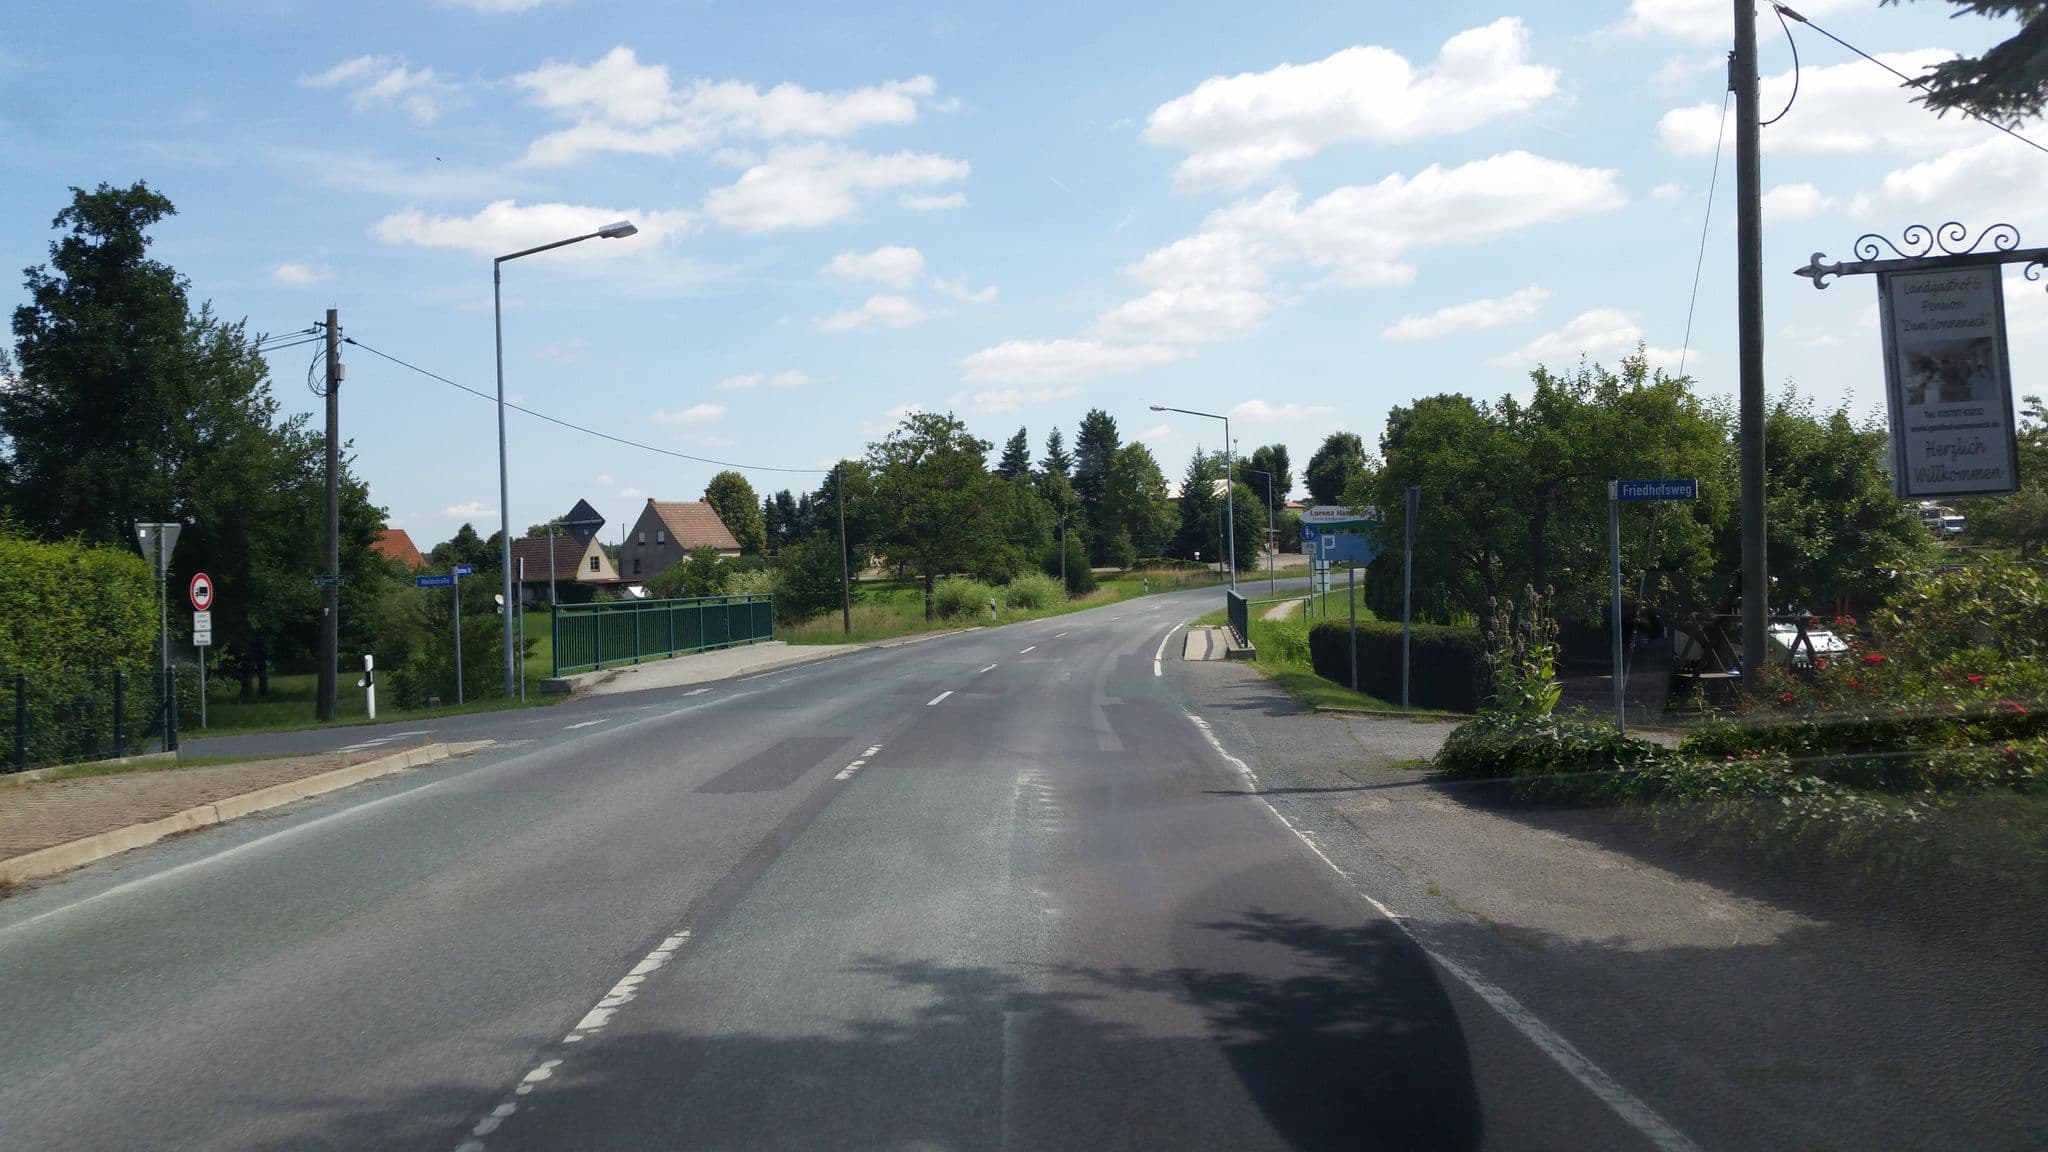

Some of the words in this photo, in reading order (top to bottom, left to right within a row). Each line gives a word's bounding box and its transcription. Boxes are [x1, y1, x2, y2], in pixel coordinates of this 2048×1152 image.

[1921, 299, 1965, 312] Pension
[1925, 436, 1986, 461] Herzlich
[1914, 464, 2002, 483] Willkommen
[1622, 484, 1692, 497] Friedhofsweg
